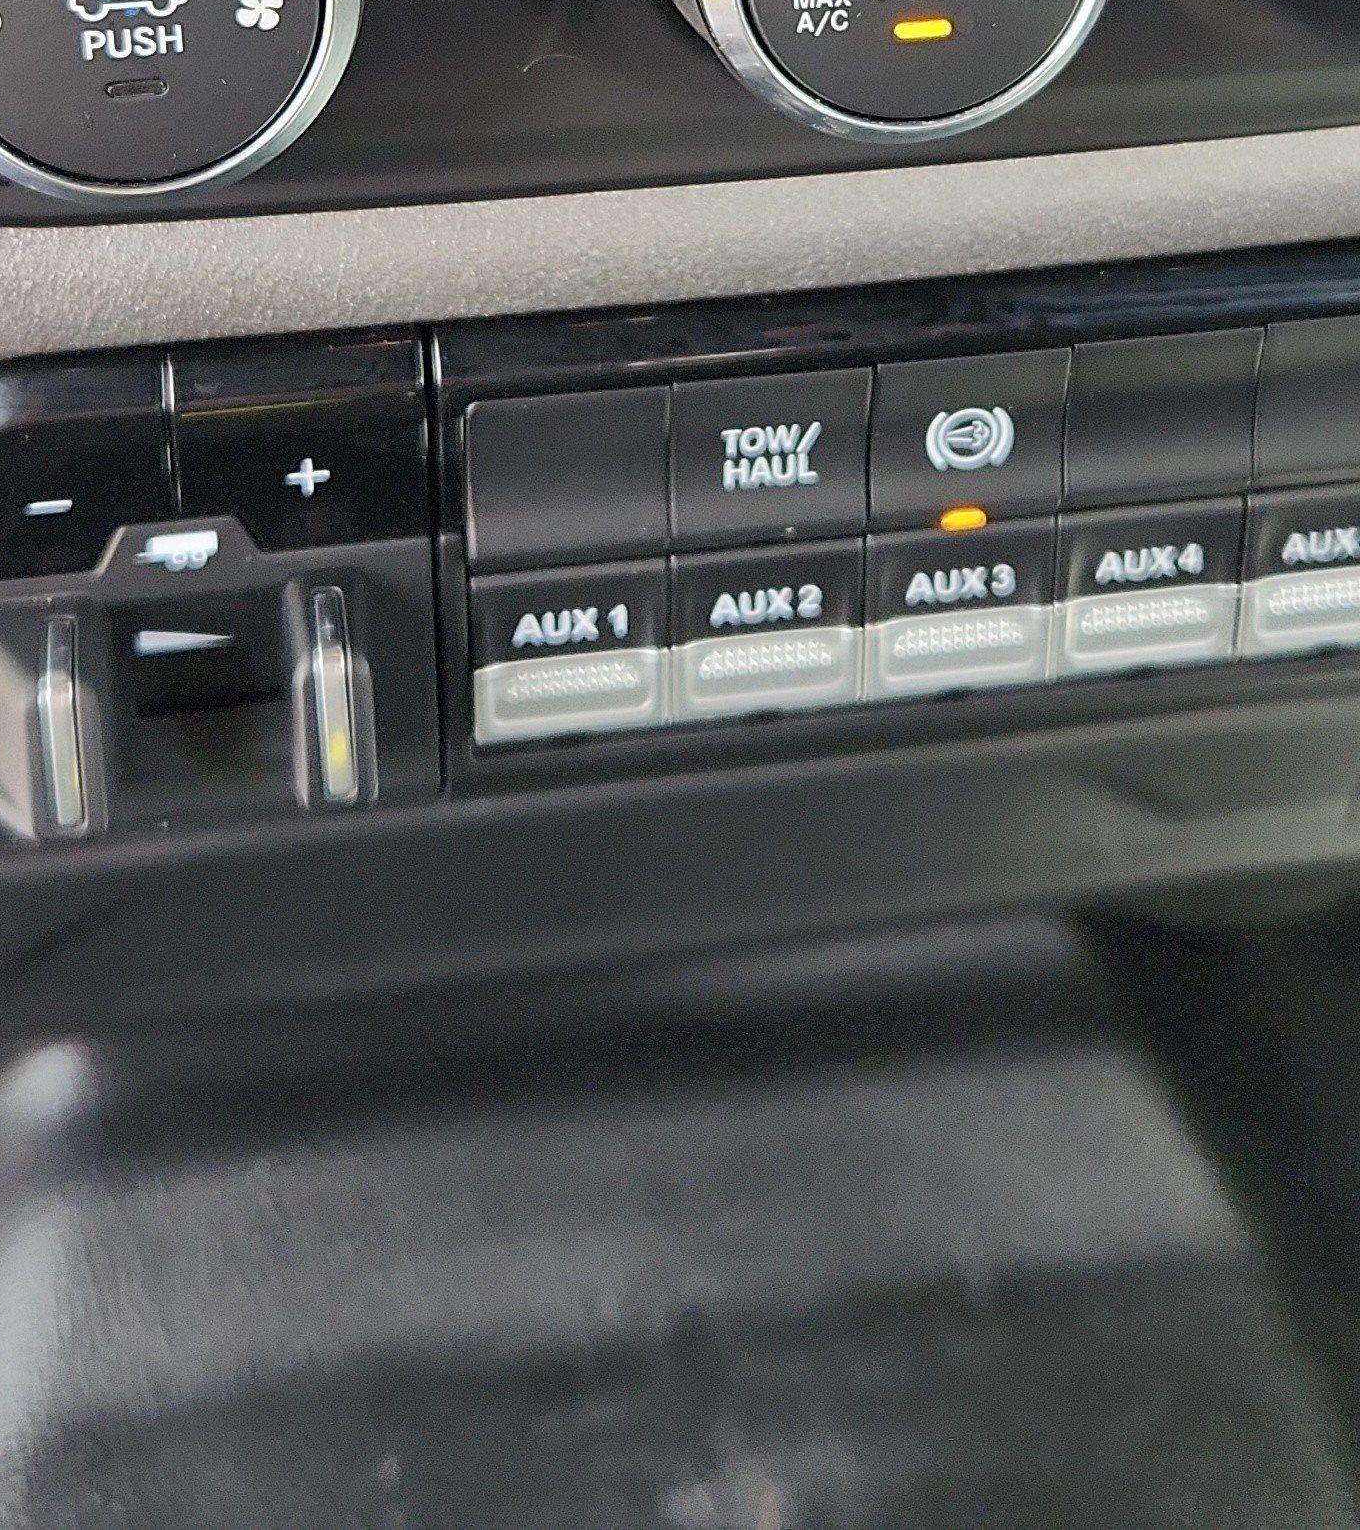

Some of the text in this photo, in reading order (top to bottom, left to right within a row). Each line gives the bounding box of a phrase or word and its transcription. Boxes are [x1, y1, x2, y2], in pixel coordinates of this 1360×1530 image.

[80, 24, 184, 61] PUSH
[796, 10, 850, 37] A/C
[720, 421, 821, 459] TOW/
[723, 454, 820, 492] HAUL
[1095, 543, 1206, 586] AUX 4
[904, 563, 1018, 607] AUX 3
[512, 603, 630, 648] AUX 1
[709, 584, 823, 628] AUX 2
